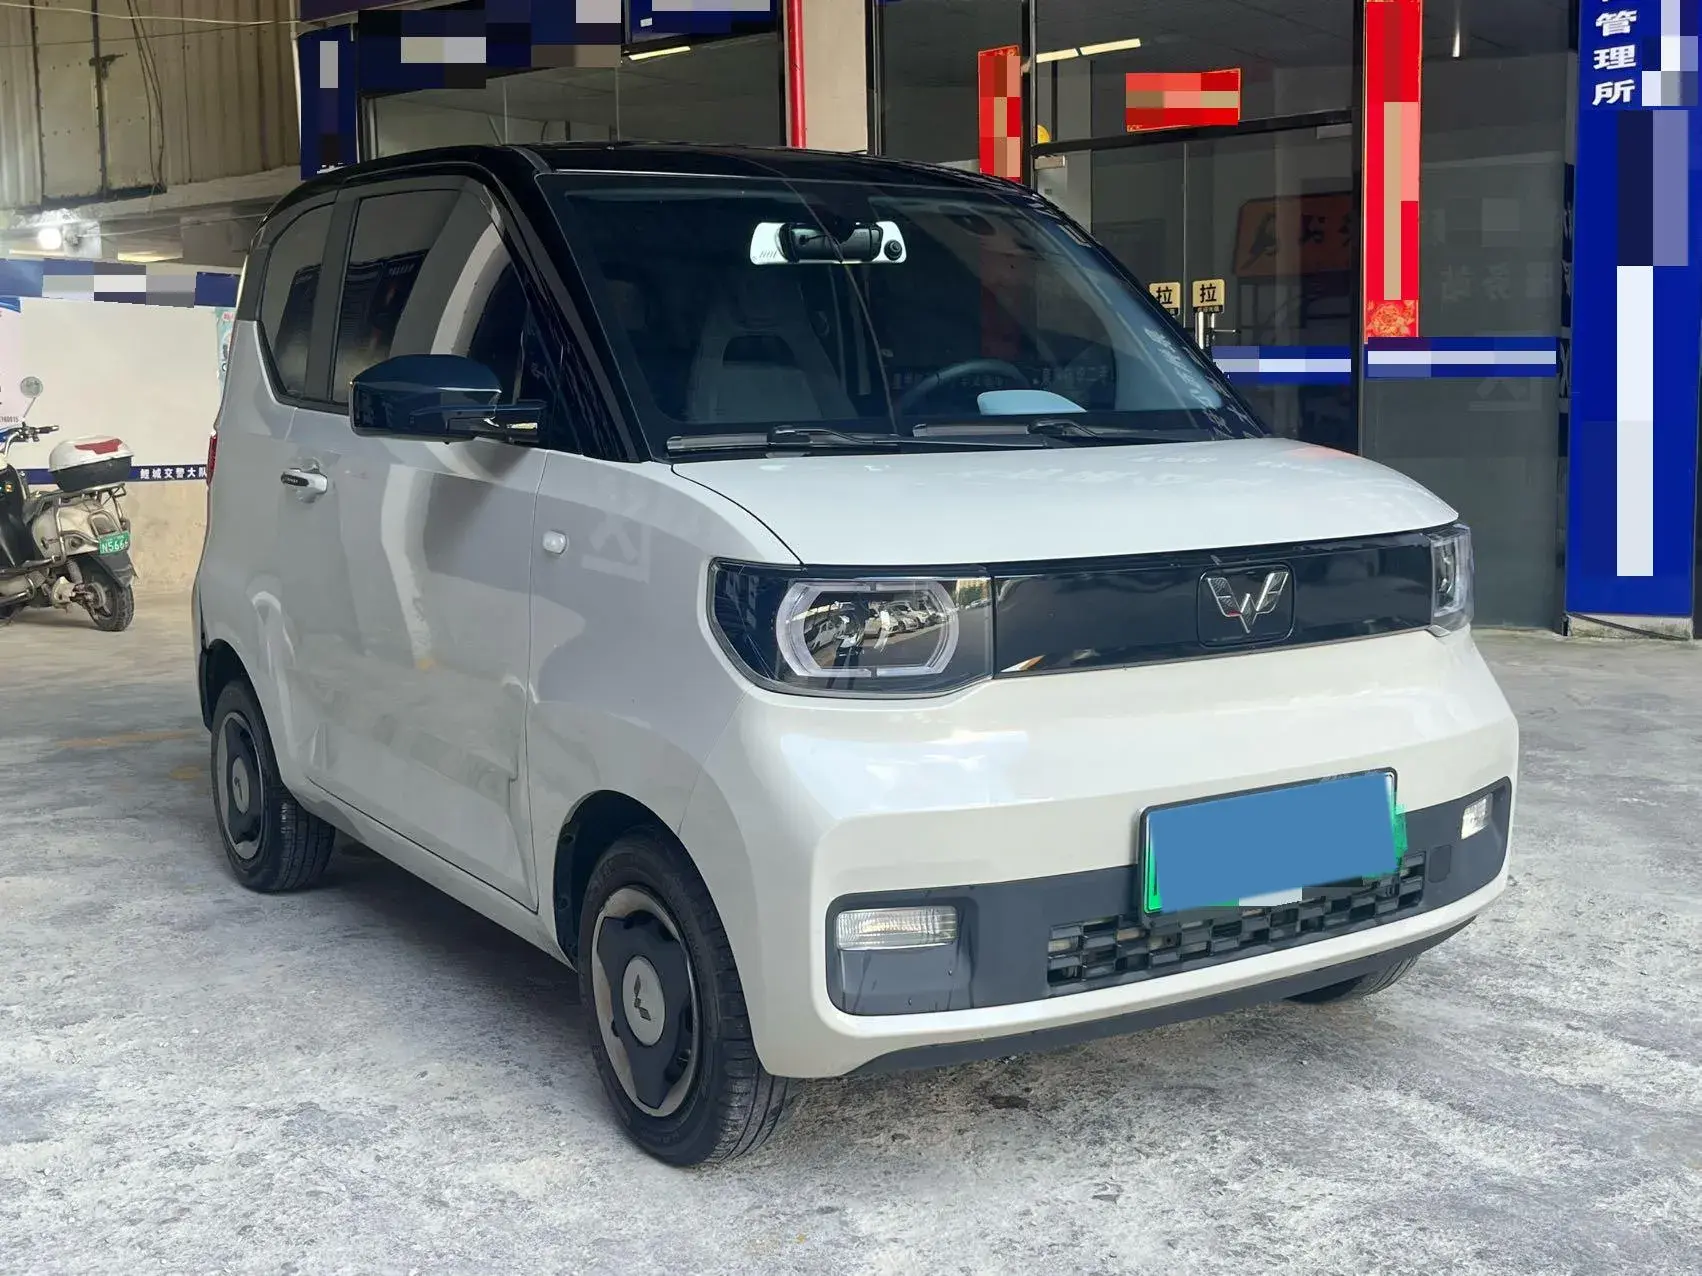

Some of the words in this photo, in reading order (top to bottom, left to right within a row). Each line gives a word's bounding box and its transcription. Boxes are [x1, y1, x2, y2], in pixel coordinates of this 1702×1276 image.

[1592, 0, 1638, 106] 管理所
[1156, 286, 1173, 304] 拉
[1199, 283, 1217, 303] 拉
[140, 466, 208, 480] 鲤城交警大队
